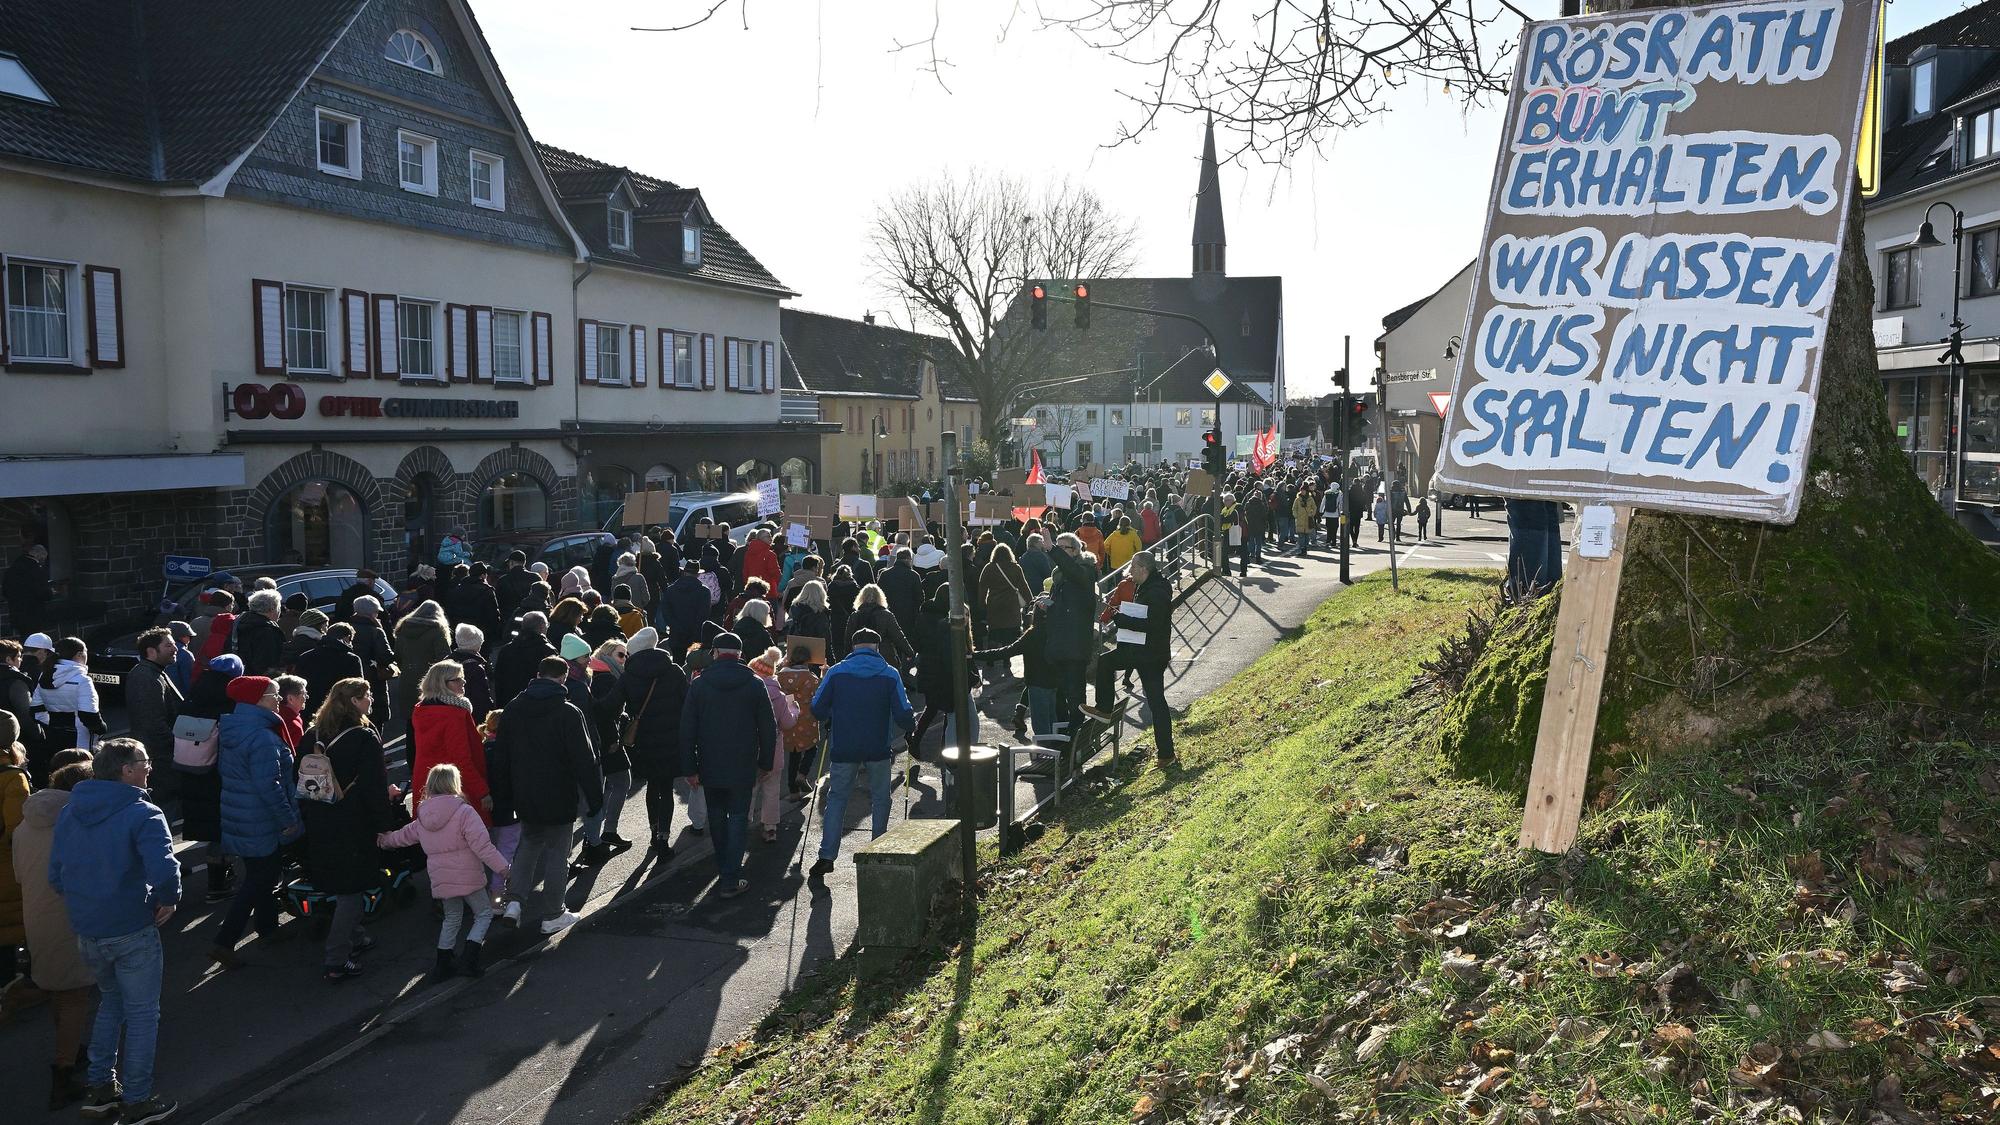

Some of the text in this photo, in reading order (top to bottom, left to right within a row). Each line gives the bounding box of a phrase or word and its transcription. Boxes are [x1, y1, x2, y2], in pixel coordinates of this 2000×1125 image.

[1529, 8, 1836, 85] RÖSRATH
[1518, 89, 1687, 146] BUNT
[1496, 235, 1835, 309] WIR LASSEN
[1386, 370, 1433, 382] Bensberger Str.
[1485, 313, 1815, 385] UNS NICHT
[319, 395, 519, 418] OPTIK GUMMERSBACH
[1462, 388, 1801, 484] SPALTEN!
